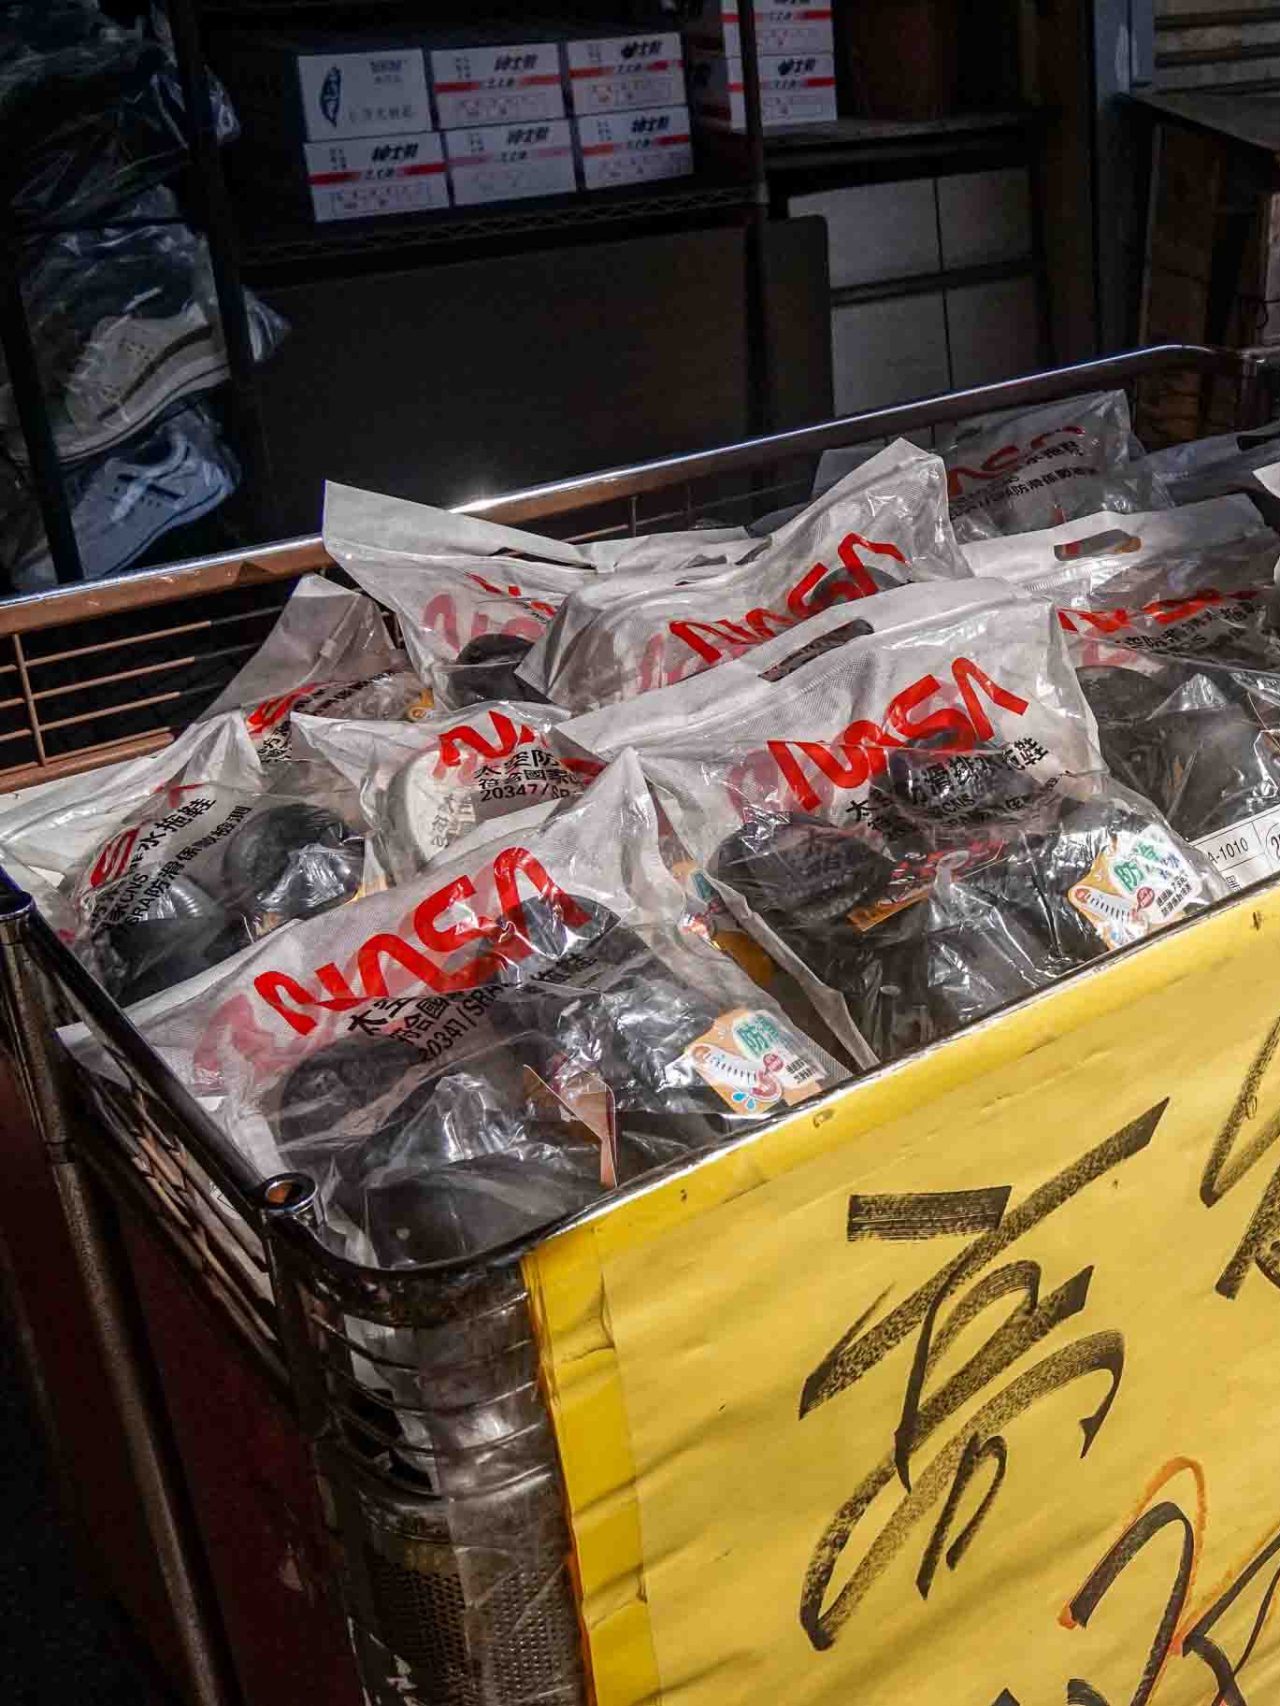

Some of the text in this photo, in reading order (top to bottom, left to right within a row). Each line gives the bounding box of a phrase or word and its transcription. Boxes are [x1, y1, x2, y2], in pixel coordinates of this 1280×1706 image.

[767, 657, 1029, 812] NASA
[1207, 836, 1250, 865] A-1010
[254, 846, 593, 1036] NASA
